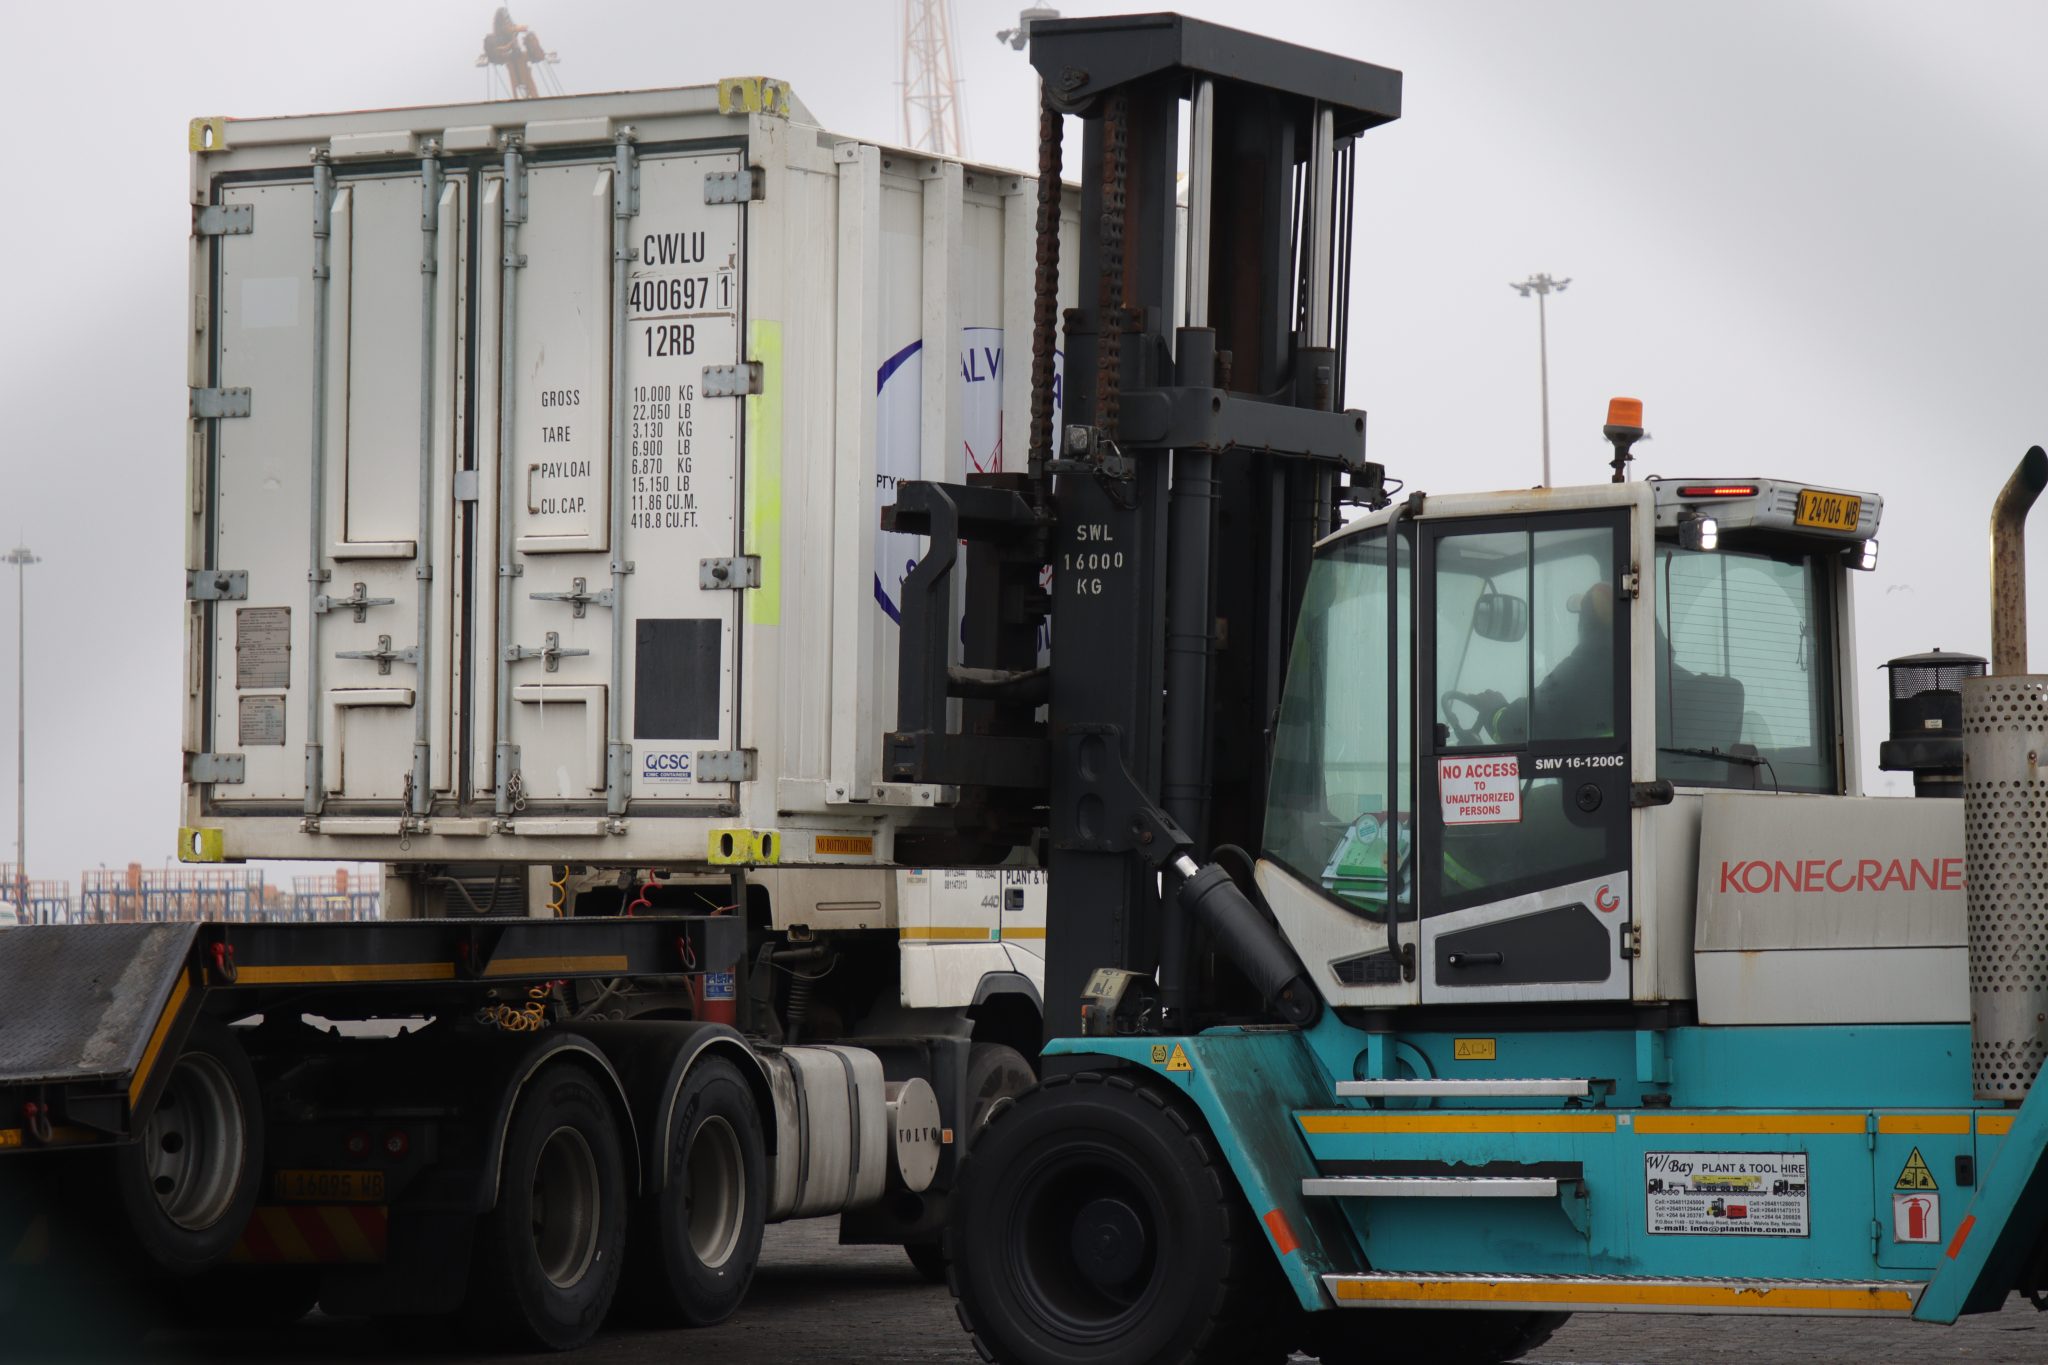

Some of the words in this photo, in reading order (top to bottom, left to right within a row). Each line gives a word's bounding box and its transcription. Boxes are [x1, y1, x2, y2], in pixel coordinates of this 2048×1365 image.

[643, 231, 706, 266] CWLU
[629, 277, 709, 313] 400697
[720, 275, 730, 307] 1
[645, 323, 696, 358] 12RB
[541, 389, 581, 407] GROSS
[679, 384, 693, 401] KG
[678, 403, 691, 419] LB
[542, 425, 571, 443] TARE
[678, 420, 693, 437] KG
[678, 439, 690, 455] LB
[677, 457, 692, 474] KG
[677, 475, 690, 491] LB
[541, 497, 587, 514] CU.CAP.
[632, 494, 662, 511] 11.86
[666, 493, 698, 510] CU.M.
[1798, 494, 1808, 520] N
[1808, 496, 1842, 524] 24906
[631, 512, 662, 529] 418.8
[665, 511, 698, 528] CU.FT.
[1077, 524, 1113, 541] SWL
[1064, 551, 1123, 570] 16000
[1077, 578, 1102, 595] KG
[645, 754, 689, 770] QCSC
[1535, 758, 1563, 769] SMV
[1566, 756, 1625, 768] 16-1200C
[1442, 765, 1462, 779] NO
[1465, 763, 1518, 778] ACCESS
[1474, 781, 1486, 791] TO
[1445, 792, 1515, 805] UNAUTHORIZED
[1459, 805, 1501, 816] PERSONS
[1006, 870, 1031, 885] PLANT
[1720, 858, 1968, 893] KONECRANE
[981, 895, 1000, 908] 440
[899, 1127, 938, 1143] VOLVO
[1702, 1163, 1736, 1173] PLANT
[1738, 1163, 1746, 1173] &
[1749, 1164, 1778, 1174] TOOL
[1781, 1165, 1806, 1174] HIRE
